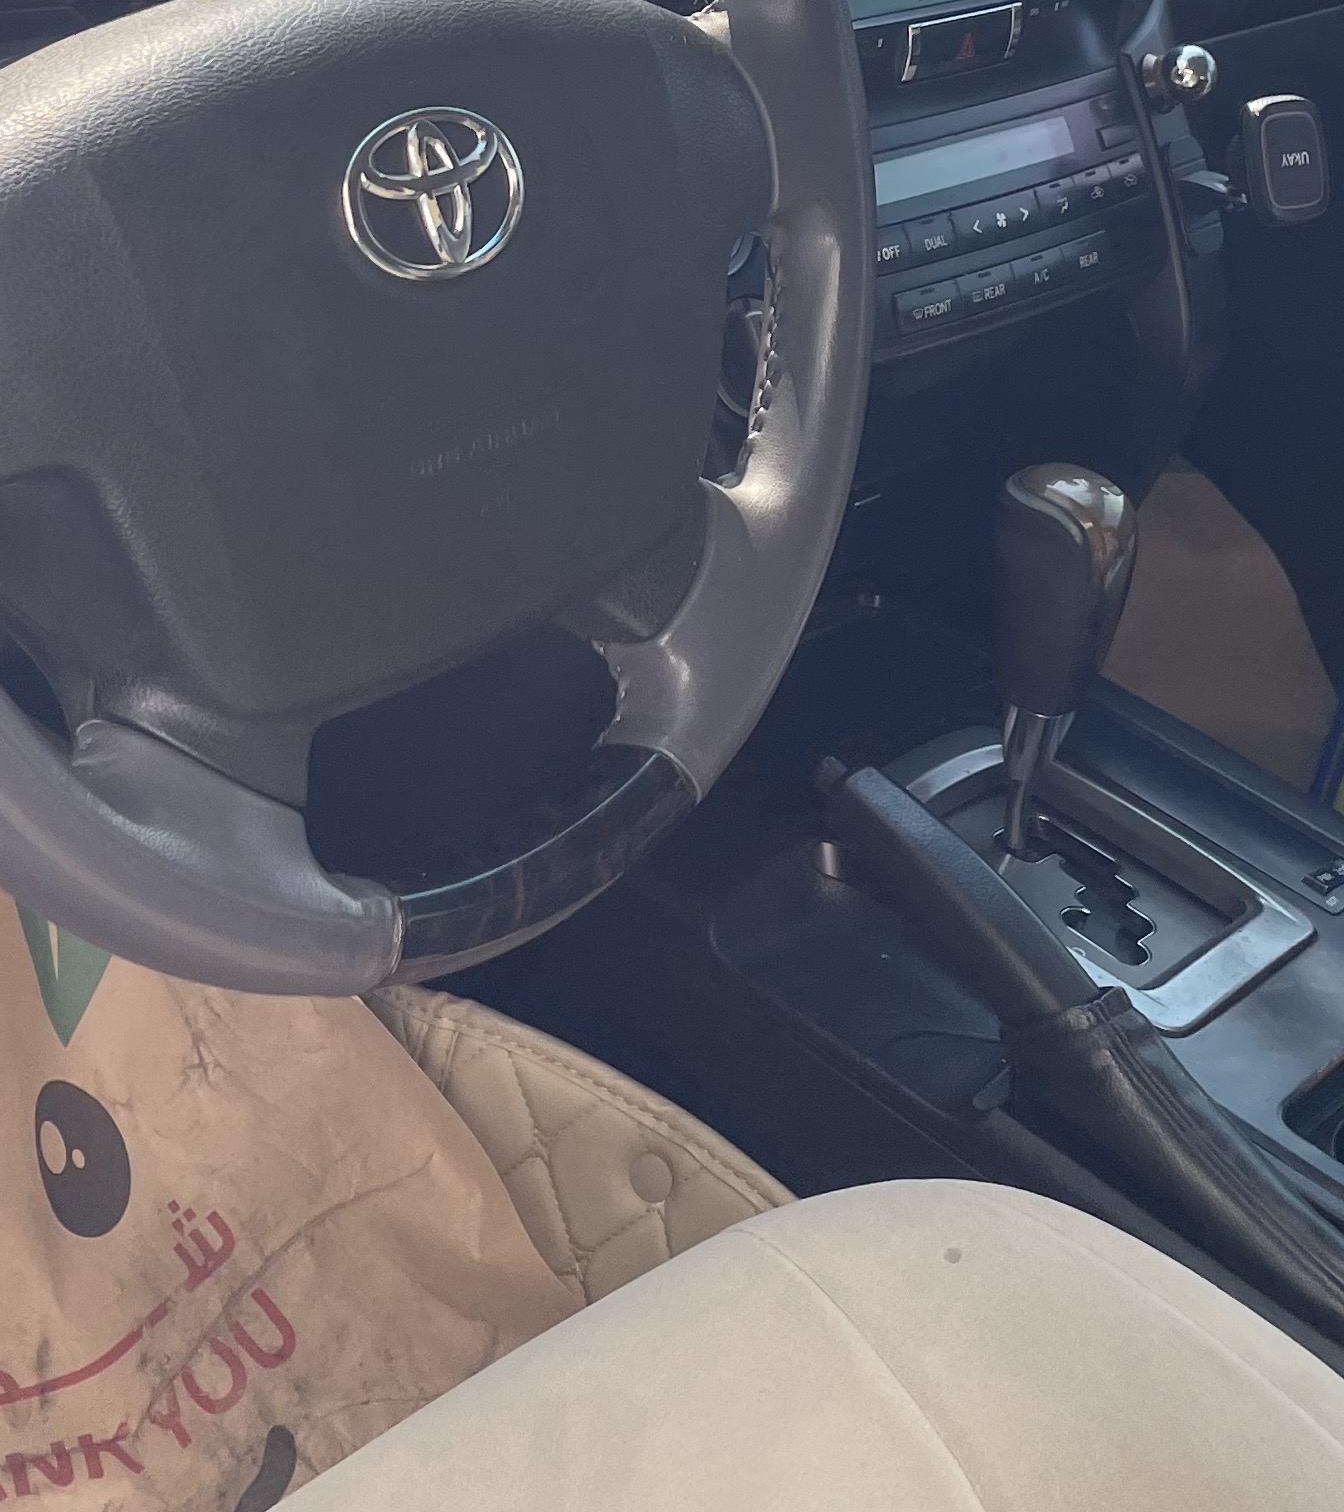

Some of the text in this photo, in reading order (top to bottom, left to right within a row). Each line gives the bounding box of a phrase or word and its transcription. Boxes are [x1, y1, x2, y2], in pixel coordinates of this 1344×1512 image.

[882, 244, 901, 261] OFF
[924, 235, 948, 252] DUAL
[1079, 251, 1098, 269] REAR
[1034, 268, 1050, 284] A/C
[984, 283, 1006, 301] REAR
[924, 299, 952, 319] FRONT
[148, 1289, 296, 1448] YOU
